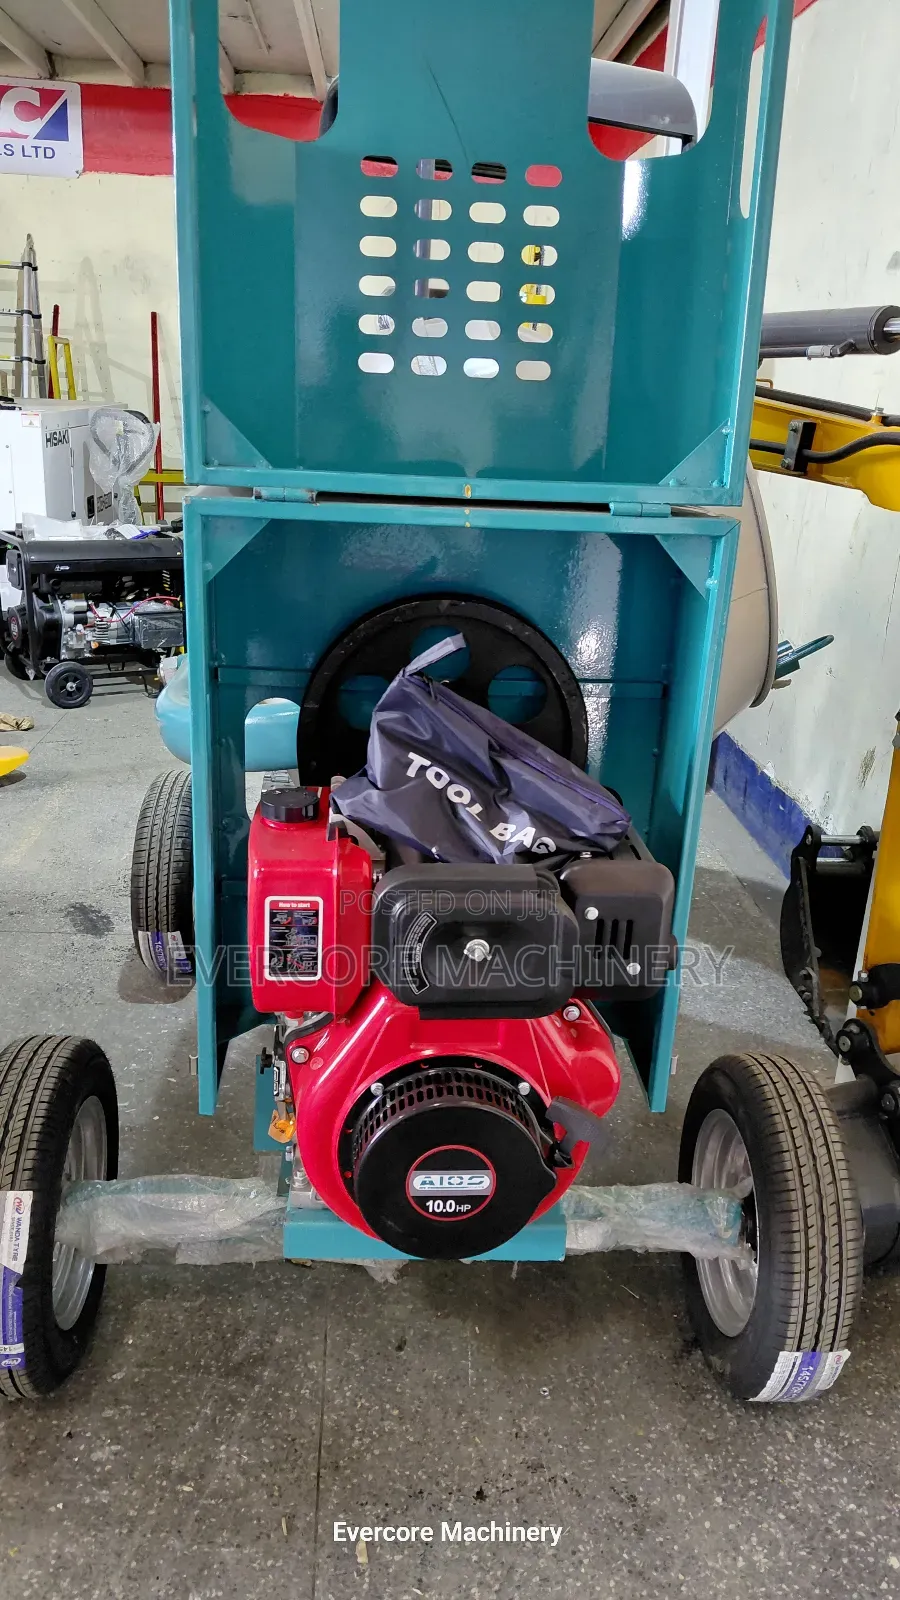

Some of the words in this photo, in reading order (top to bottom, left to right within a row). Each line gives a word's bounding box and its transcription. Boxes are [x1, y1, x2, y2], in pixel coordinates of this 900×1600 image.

[21, 145, 56, 159] LTD
[45, 429, 70, 448] HISAKI
[405, 751, 484, 822] TOOL
[489, 822, 558, 855] BAG
[419, 1176, 485, 1186] AIOS
[14, 1217, 23, 1242] WANDA
